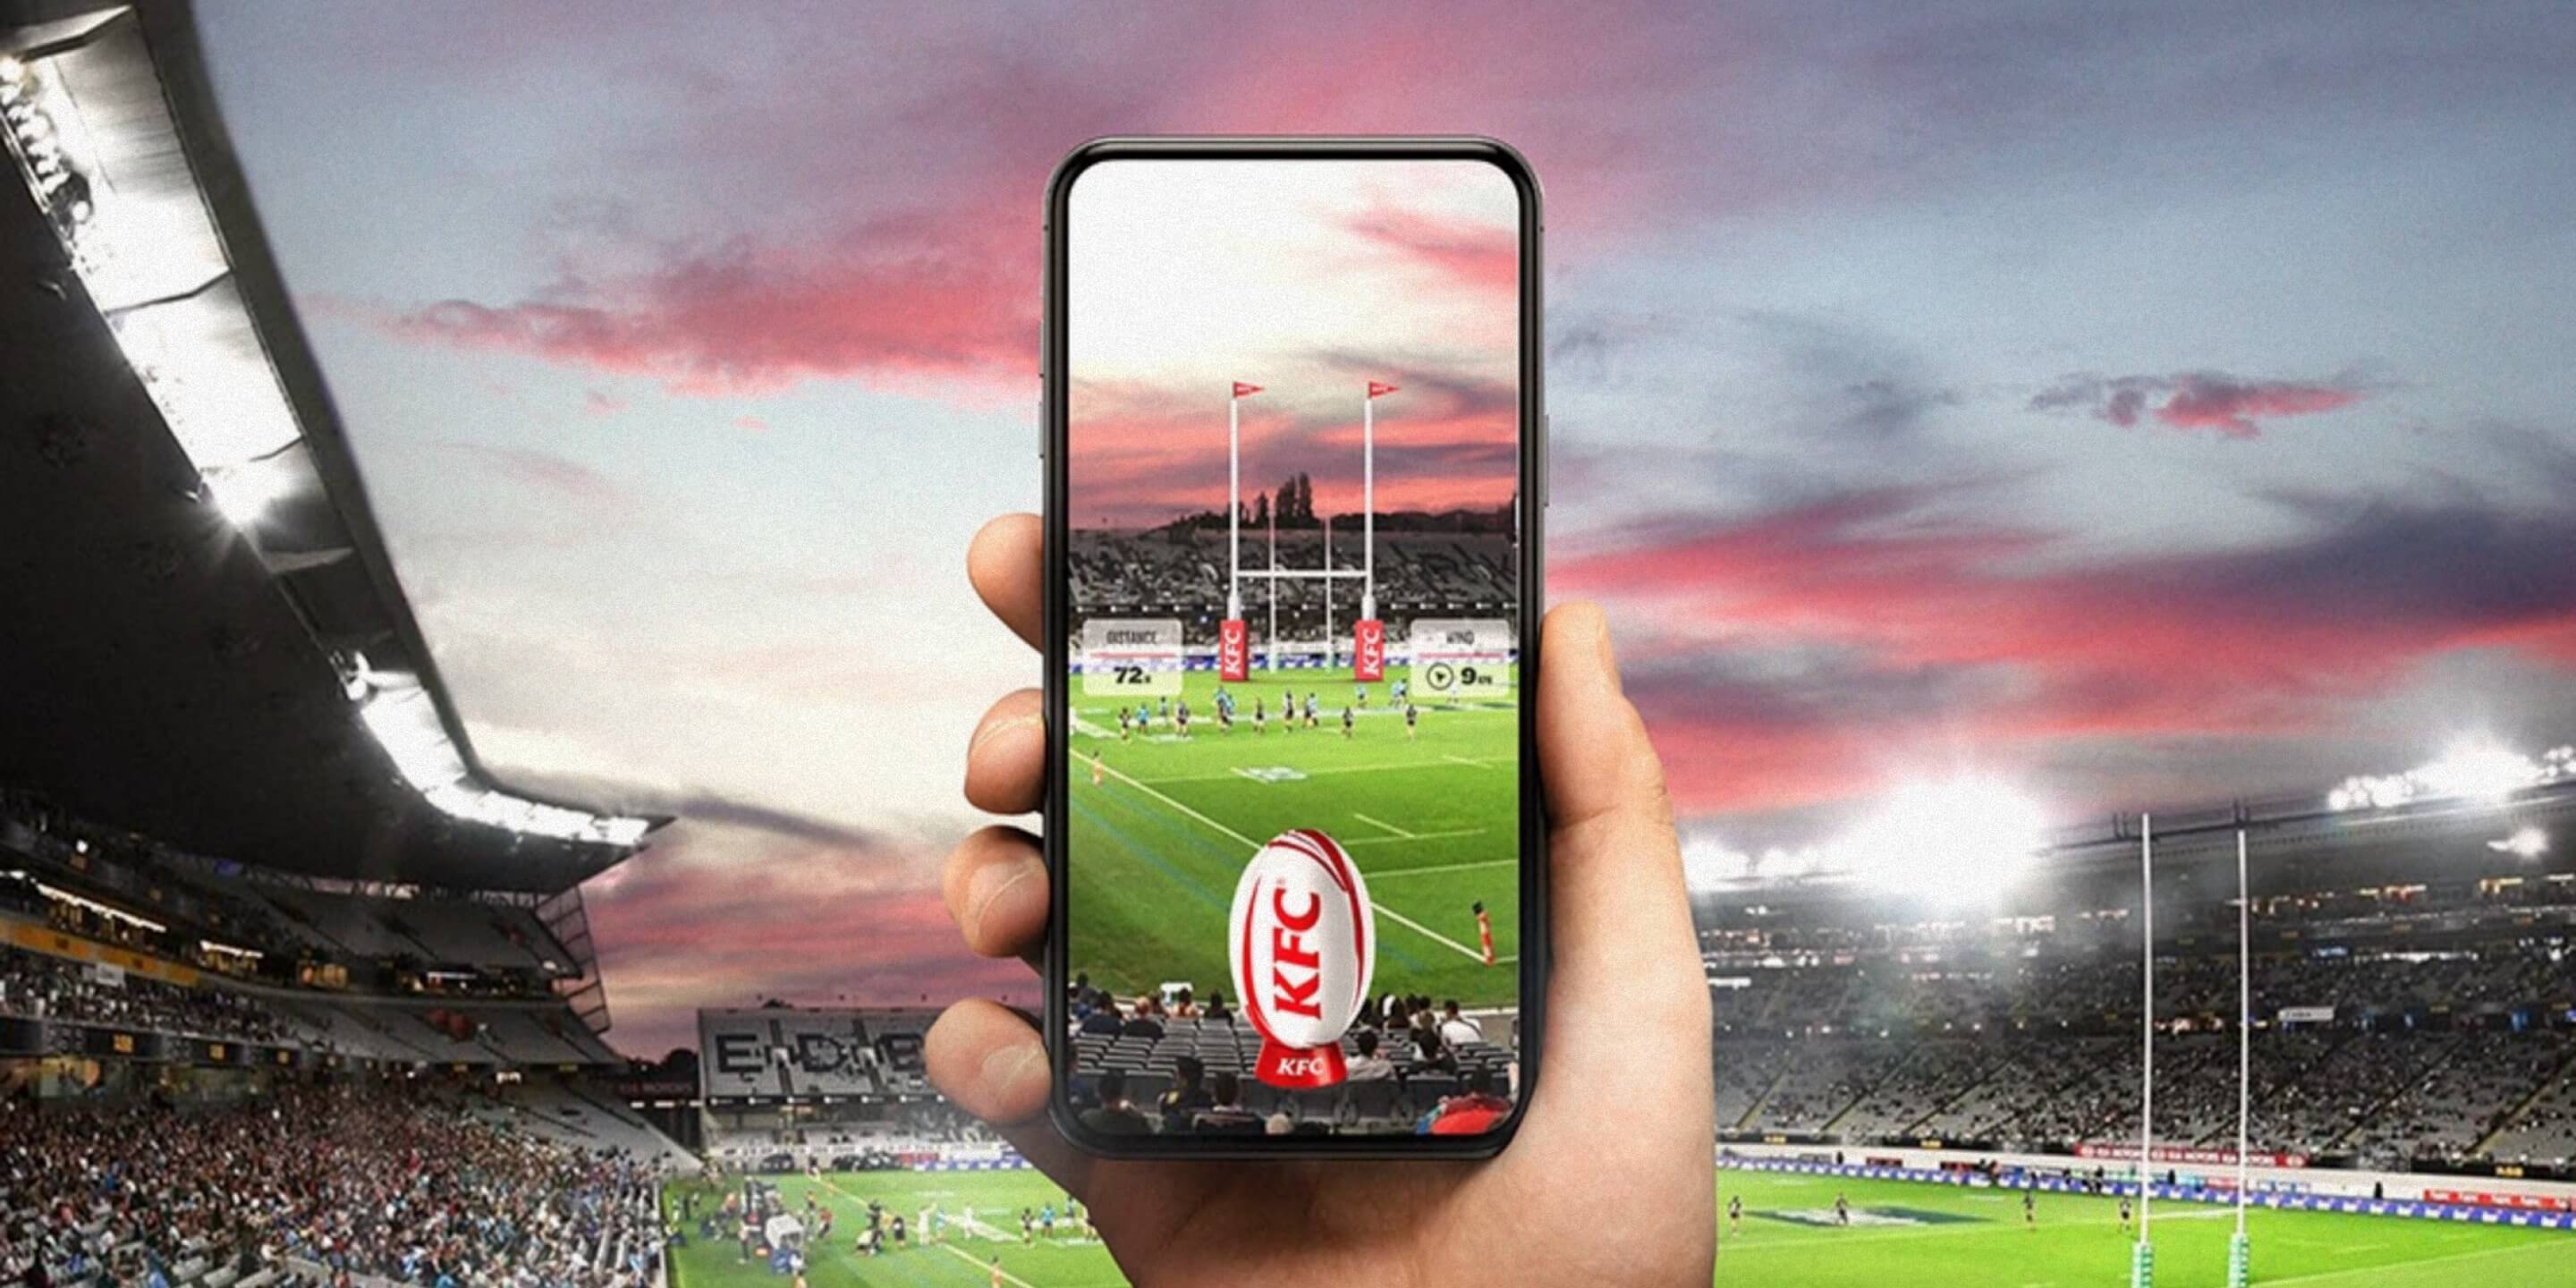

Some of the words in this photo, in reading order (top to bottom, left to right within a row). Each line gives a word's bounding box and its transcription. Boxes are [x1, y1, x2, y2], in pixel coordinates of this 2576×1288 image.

[1224, 629, 1241, 677] KFC
[1362, 629, 1380, 677] KFC
[1273, 887, 1322, 1021] KFC
[1276, 1056, 1325, 1075] KFC
